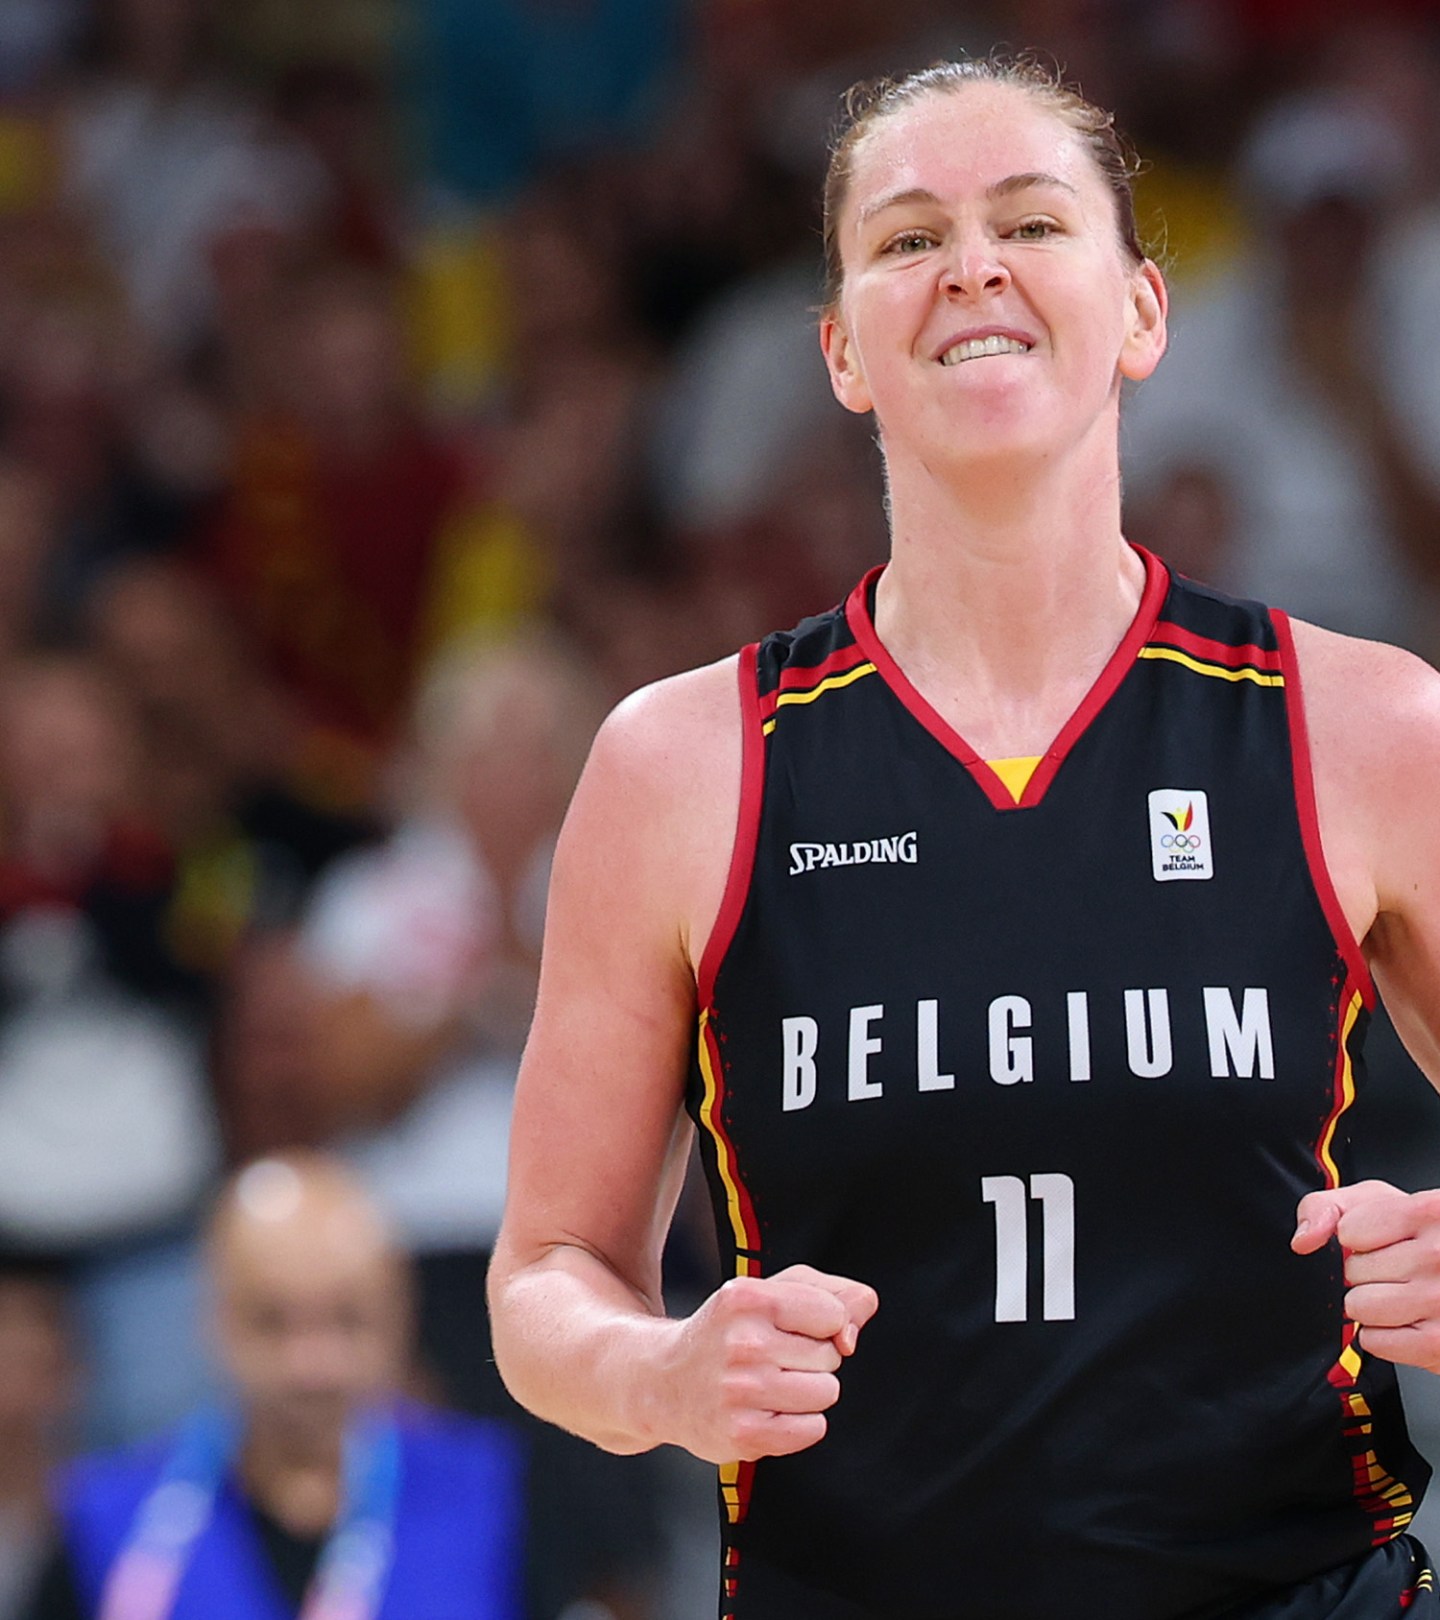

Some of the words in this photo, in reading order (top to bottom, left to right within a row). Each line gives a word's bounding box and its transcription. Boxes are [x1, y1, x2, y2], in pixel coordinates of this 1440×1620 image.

[789, 831, 917, 875] SPALDING
[1162, 863, 1204, 871] BELGIUM
[782, 987, 1275, 1112] BELGIUM
[981, 1173, 1077, 1323] 11
